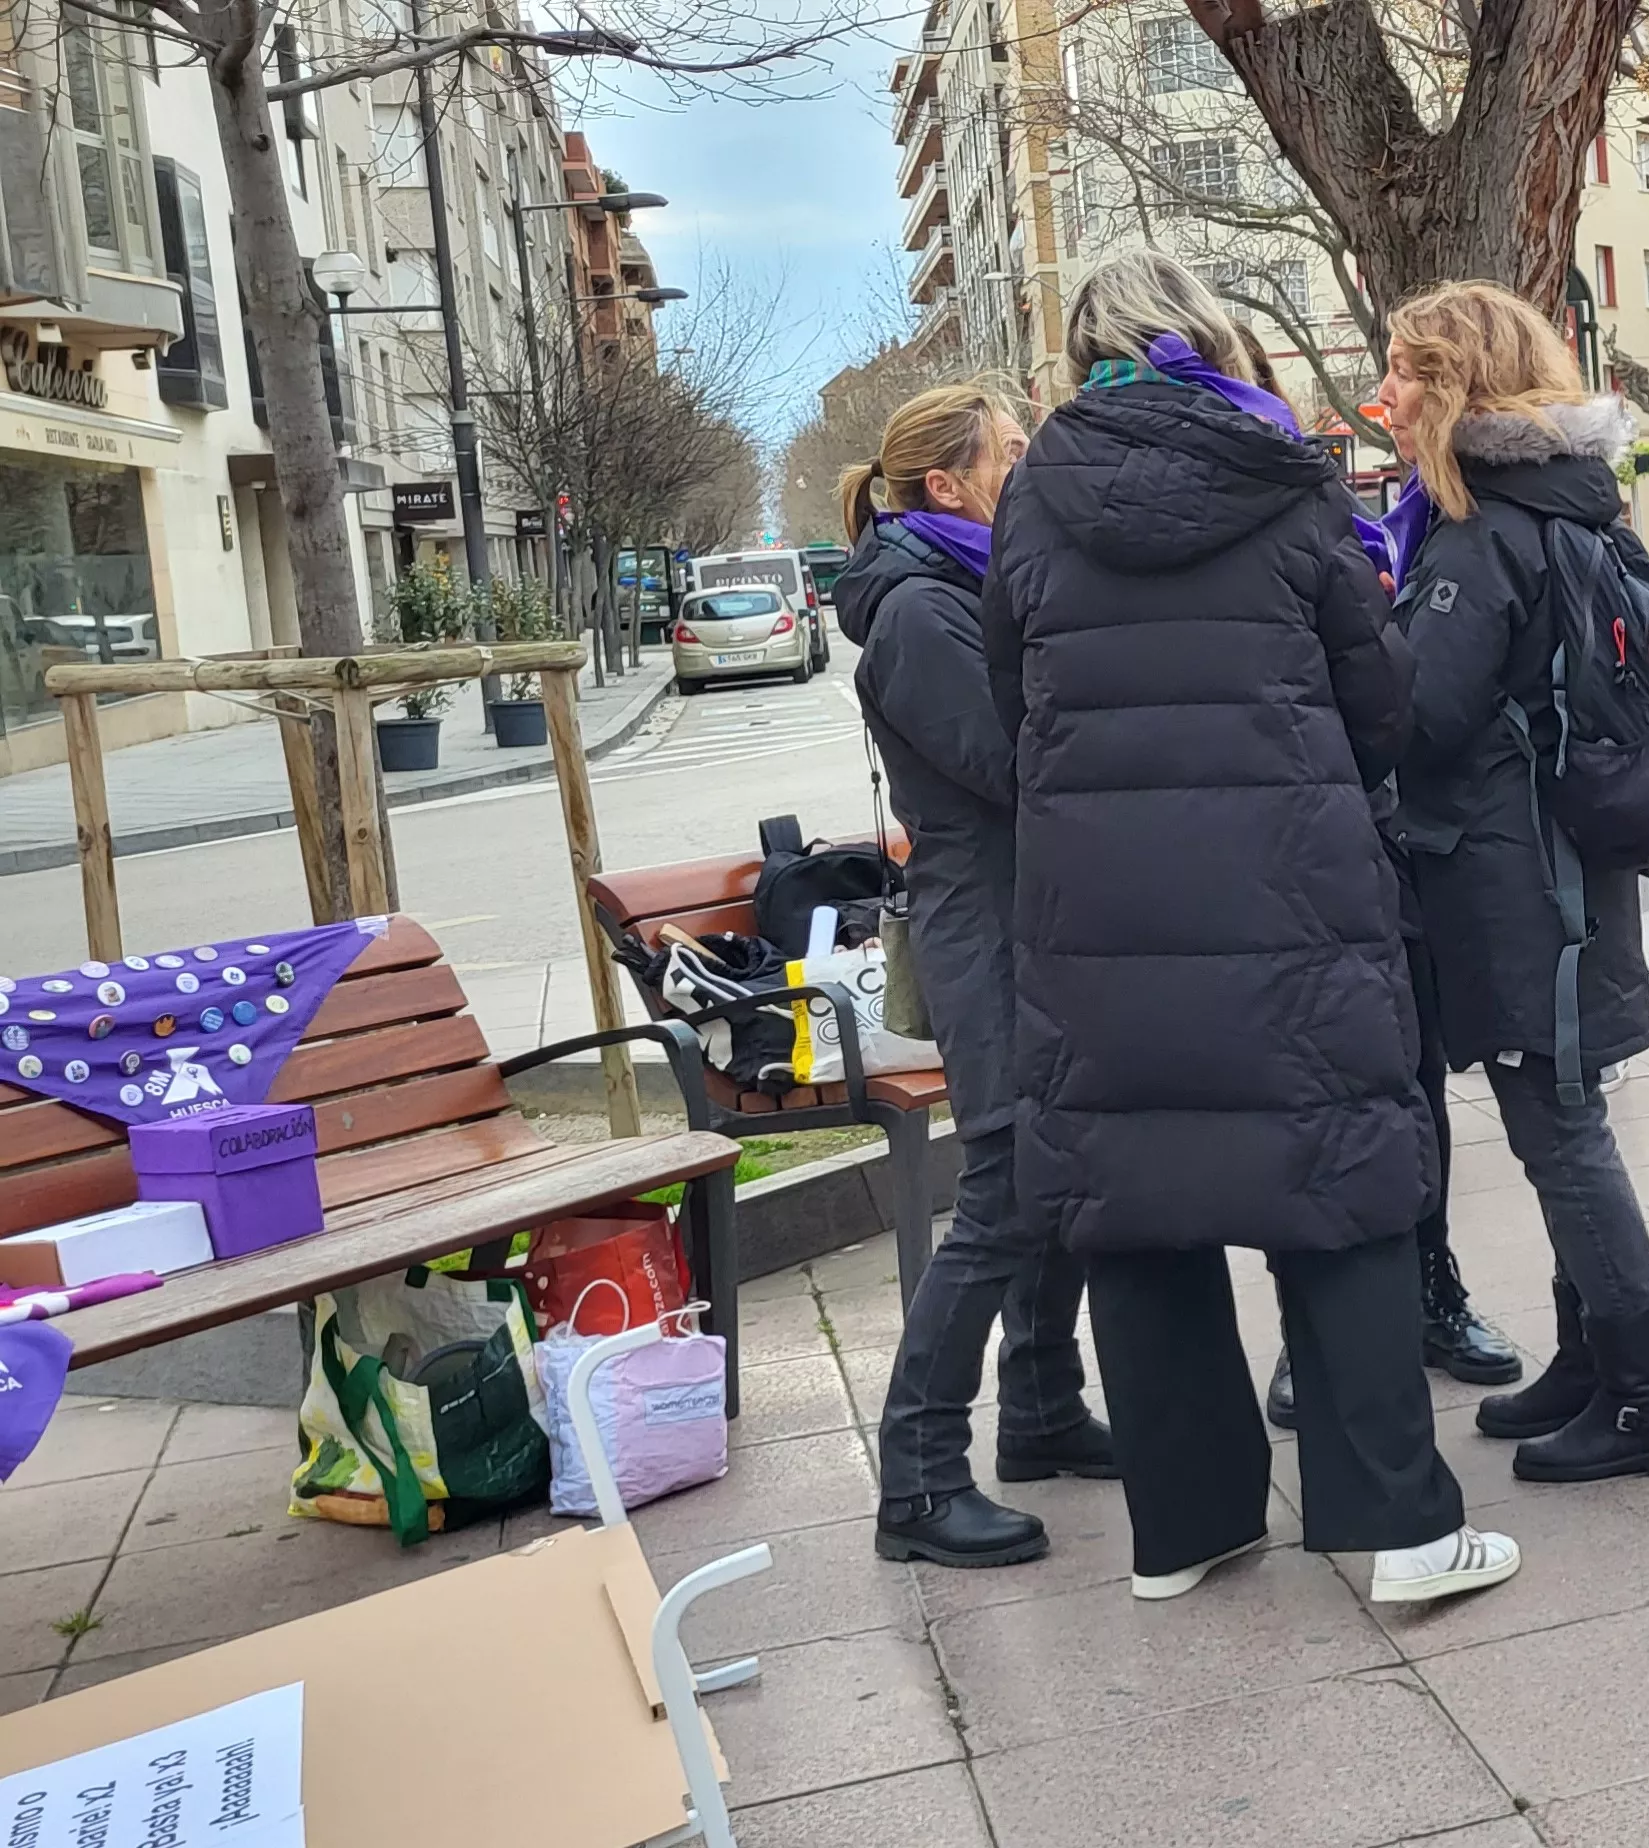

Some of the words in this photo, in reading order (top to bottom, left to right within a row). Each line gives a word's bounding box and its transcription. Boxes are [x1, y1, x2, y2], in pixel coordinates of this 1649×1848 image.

[144, 1069, 172, 1096] 8M
[169, 1098, 232, 1119] HUESCA
[148, 1749, 188, 1775] x3
[7, 1807, 44, 1848] ismo
